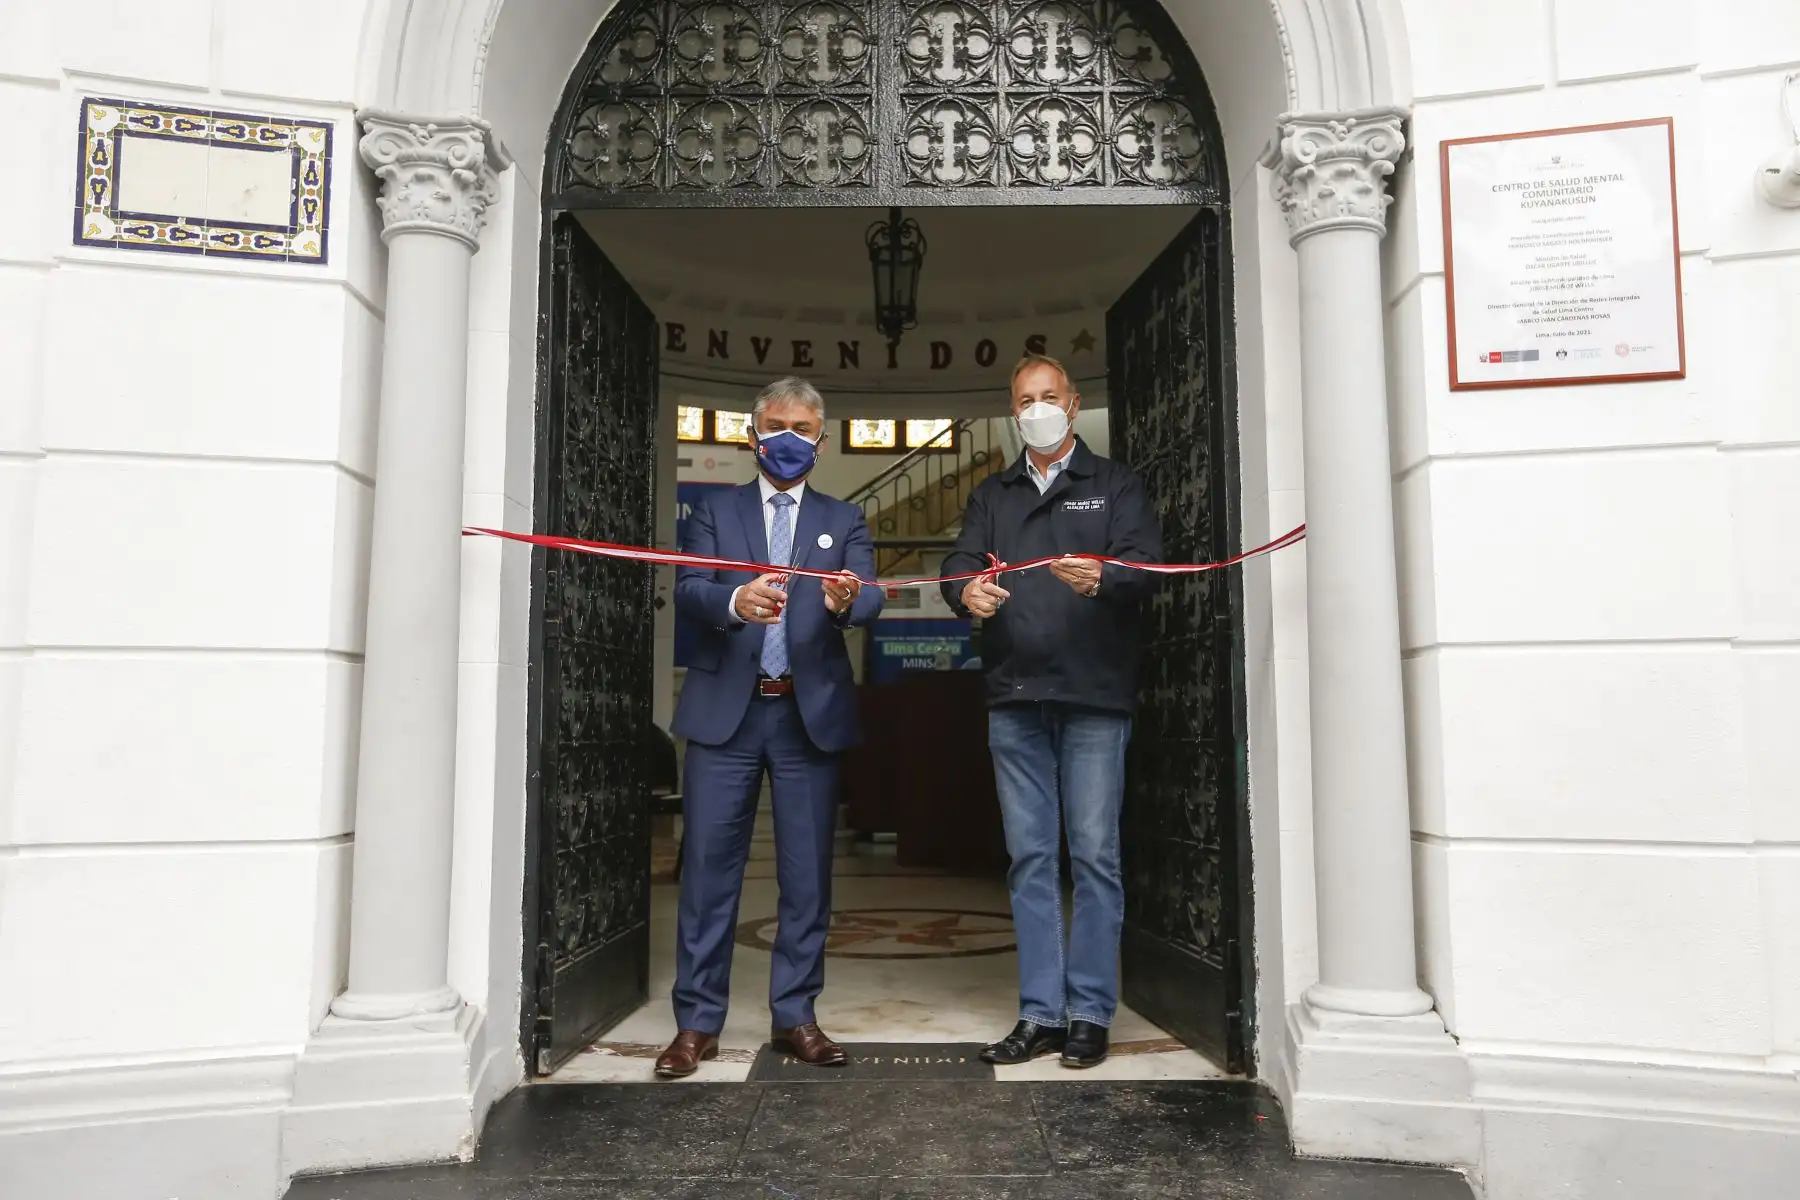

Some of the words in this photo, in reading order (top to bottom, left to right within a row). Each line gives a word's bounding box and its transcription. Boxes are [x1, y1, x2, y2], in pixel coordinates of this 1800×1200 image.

[1492, 182, 1530, 193] CENTRO
[1533, 180, 1546, 190] DE
[1549, 177, 1580, 188] SALUD
[1584, 173, 1624, 184] MENTAL
[1522, 185, 1594, 199] COMUNITARIO
[1521, 196, 1596, 209] KUYANAKUSUN
[903, 658, 936, 669] MINS
